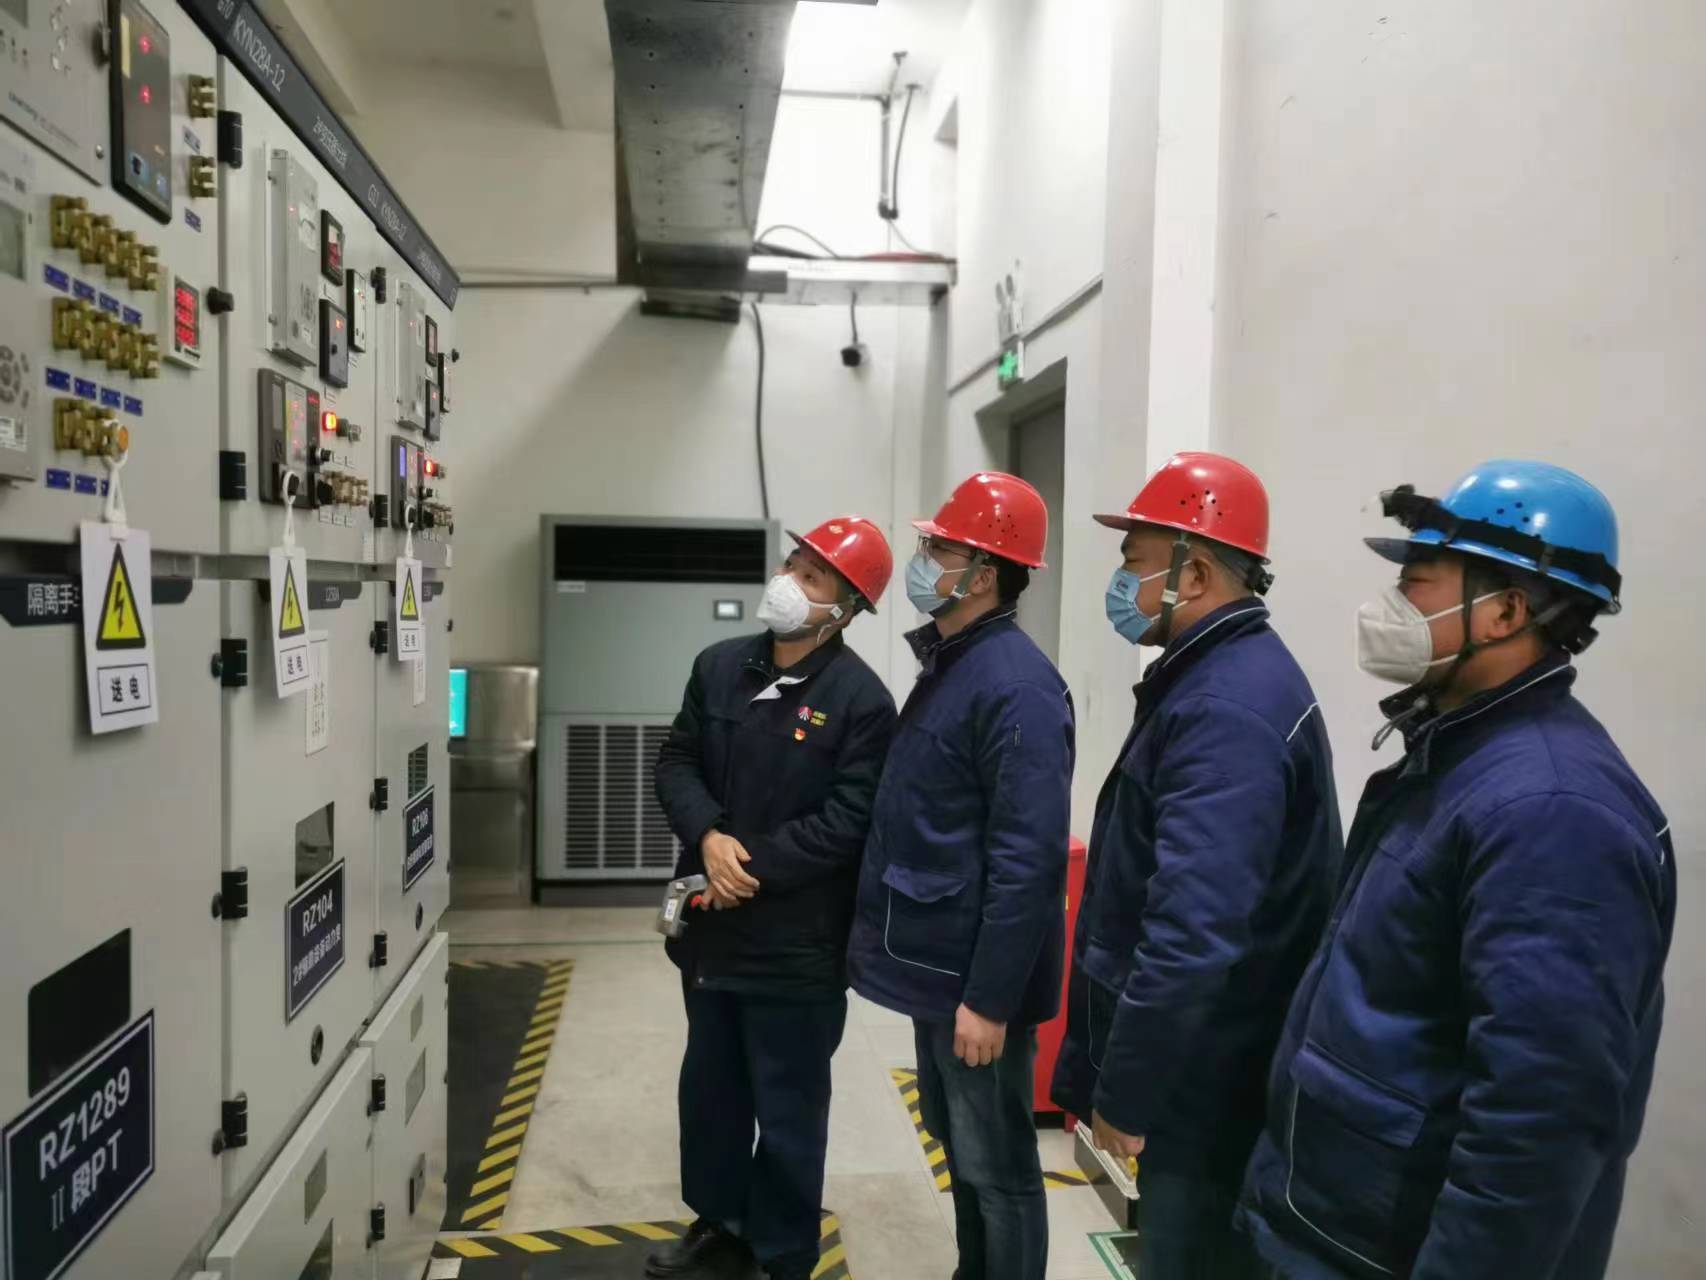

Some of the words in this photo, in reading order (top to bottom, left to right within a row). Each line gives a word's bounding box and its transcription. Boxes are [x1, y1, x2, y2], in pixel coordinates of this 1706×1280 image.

[233, 14, 286, 93] KYN28A-12
[302, 888, 334, 937] RZ104
[39, 1066, 131, 1181] RZ1289
